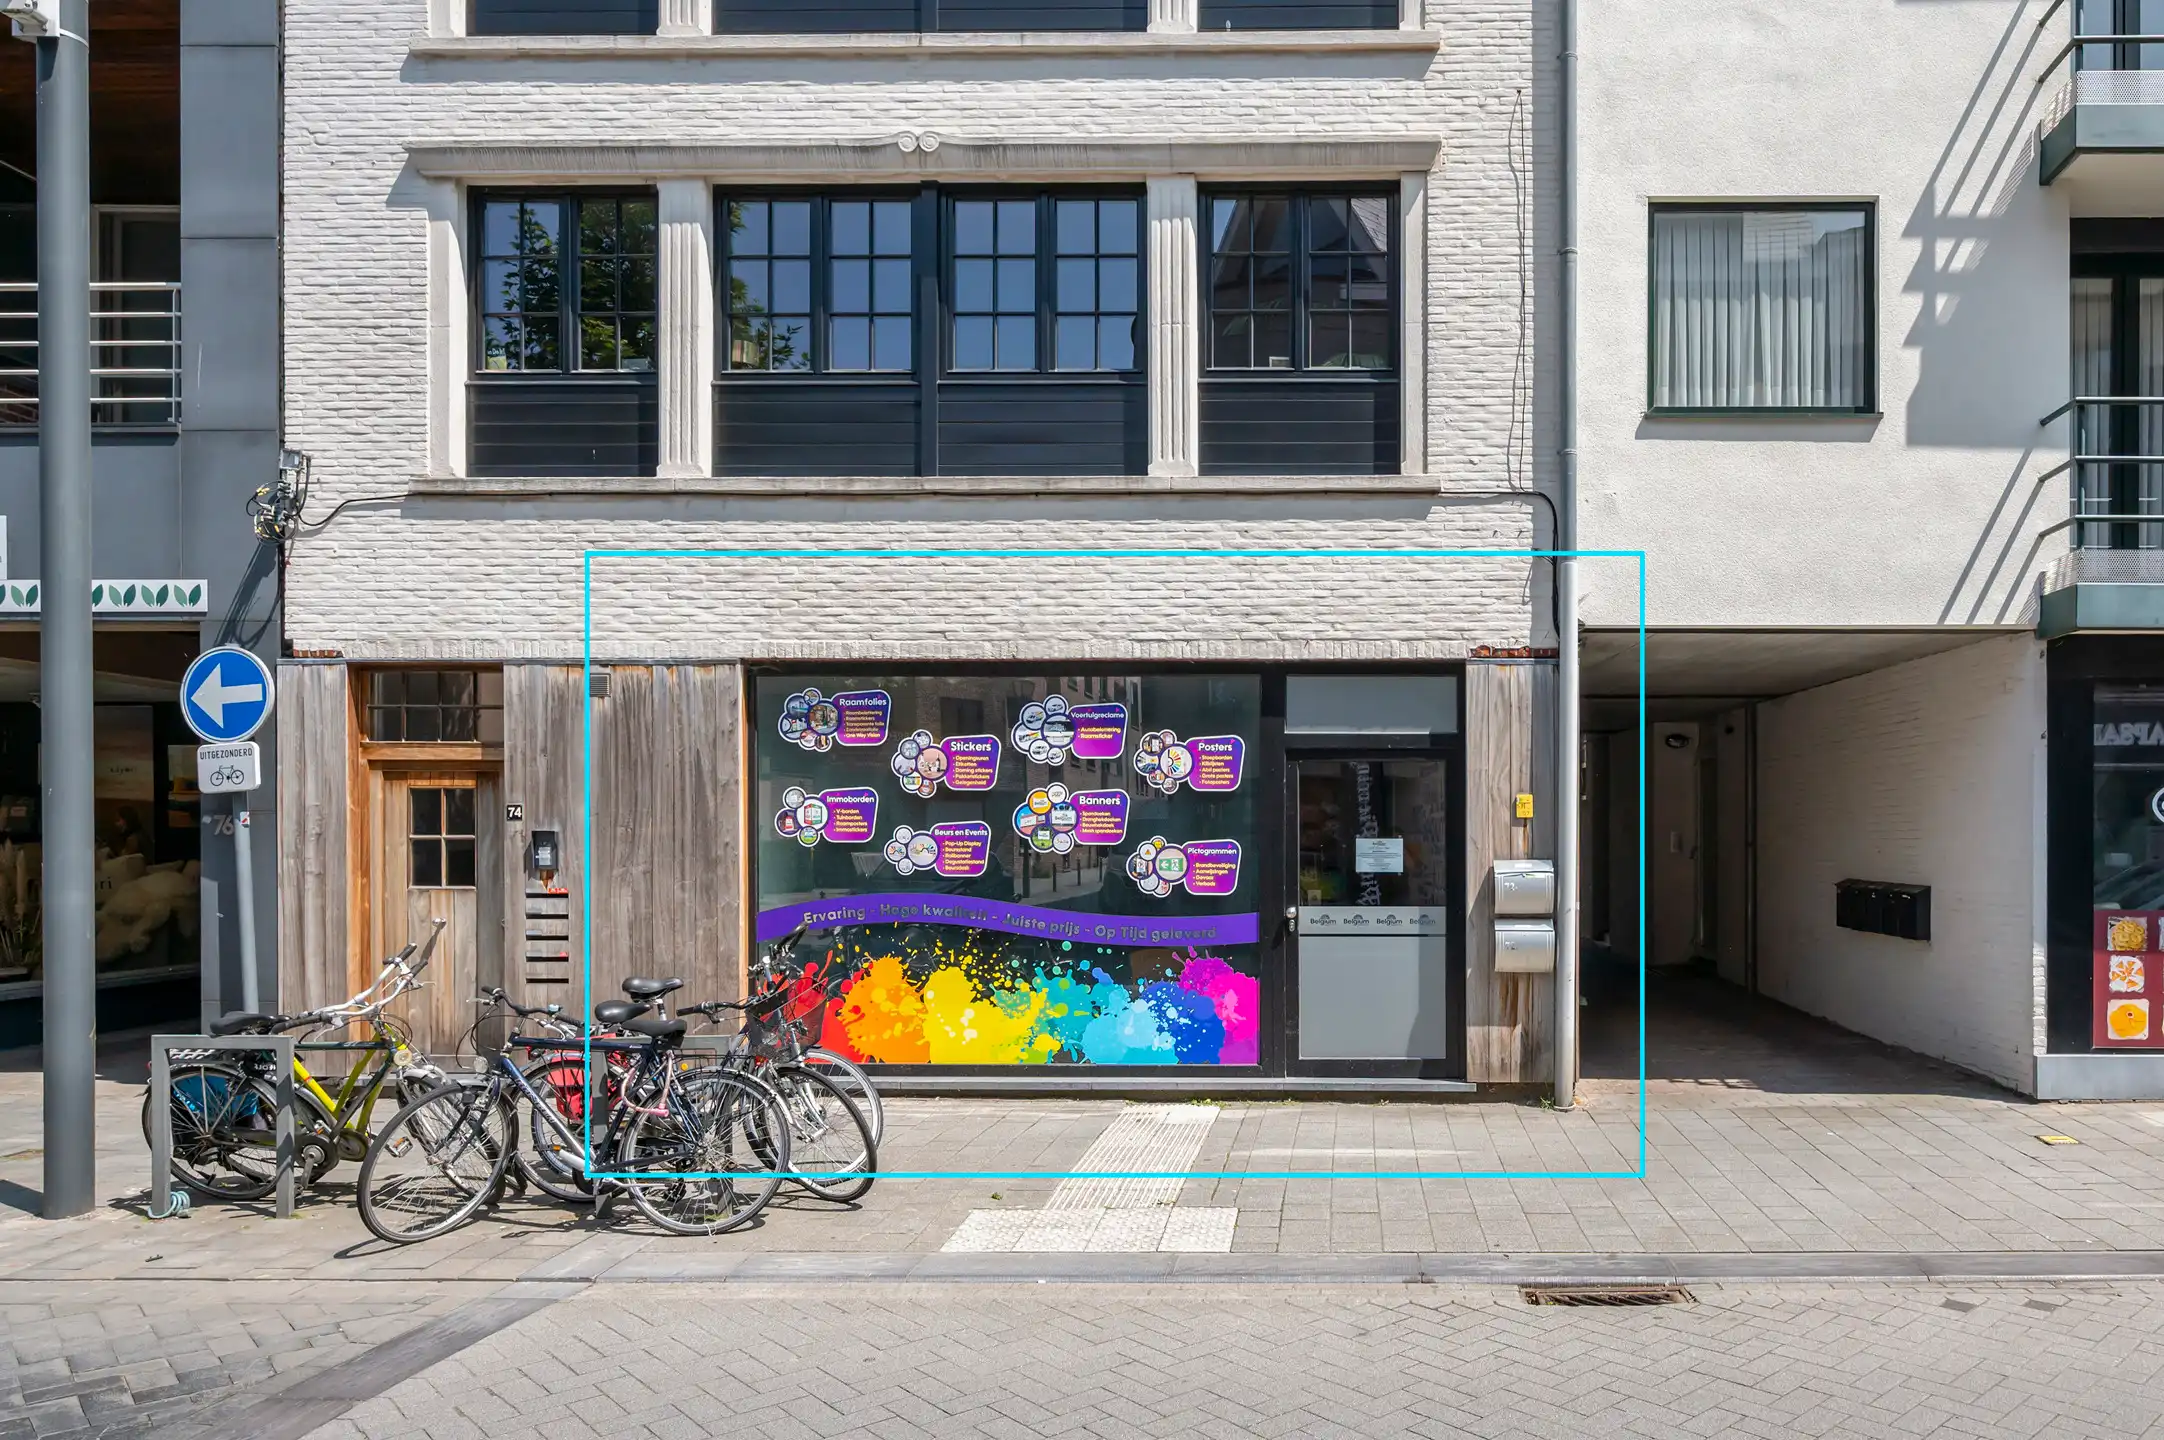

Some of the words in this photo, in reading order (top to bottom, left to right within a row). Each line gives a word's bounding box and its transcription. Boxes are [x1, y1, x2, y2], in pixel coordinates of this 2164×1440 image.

[839, 697, 887, 706] Raamfolies
[1070, 712, 1125, 720] Voertuigreclame
[950, 741, 992, 752] Stickers
[1198, 742, 1233, 752] Posters
[199, 746, 253, 761] UITGEZONDERD
[826, 795, 875, 804] Immoborden
[1079, 795, 1121, 805] Banners
[507, 805, 522, 818] 74
[213, 814, 235, 836] 76
[934, 828, 954, 836] Beurs
[964, 828, 988, 836] Events
[1187, 847, 1237, 857] Pictogrammen
[803, 906, 866, 924] Ervaring
[879, 903, 919, 919] Hoge
[1001, 913, 1046, 932] Juiste
[1048, 920, 1081, 936] prijs
[1094, 925, 1117, 940] Op
[1120, 926, 1148, 941] Tijd
[1151, 927, 1217, 943] geleverd
[1310, 918, 1337, 926] Belgium
[1343, 918, 1370, 926] Belgium
[1376, 918, 1403, 926] Belgium
